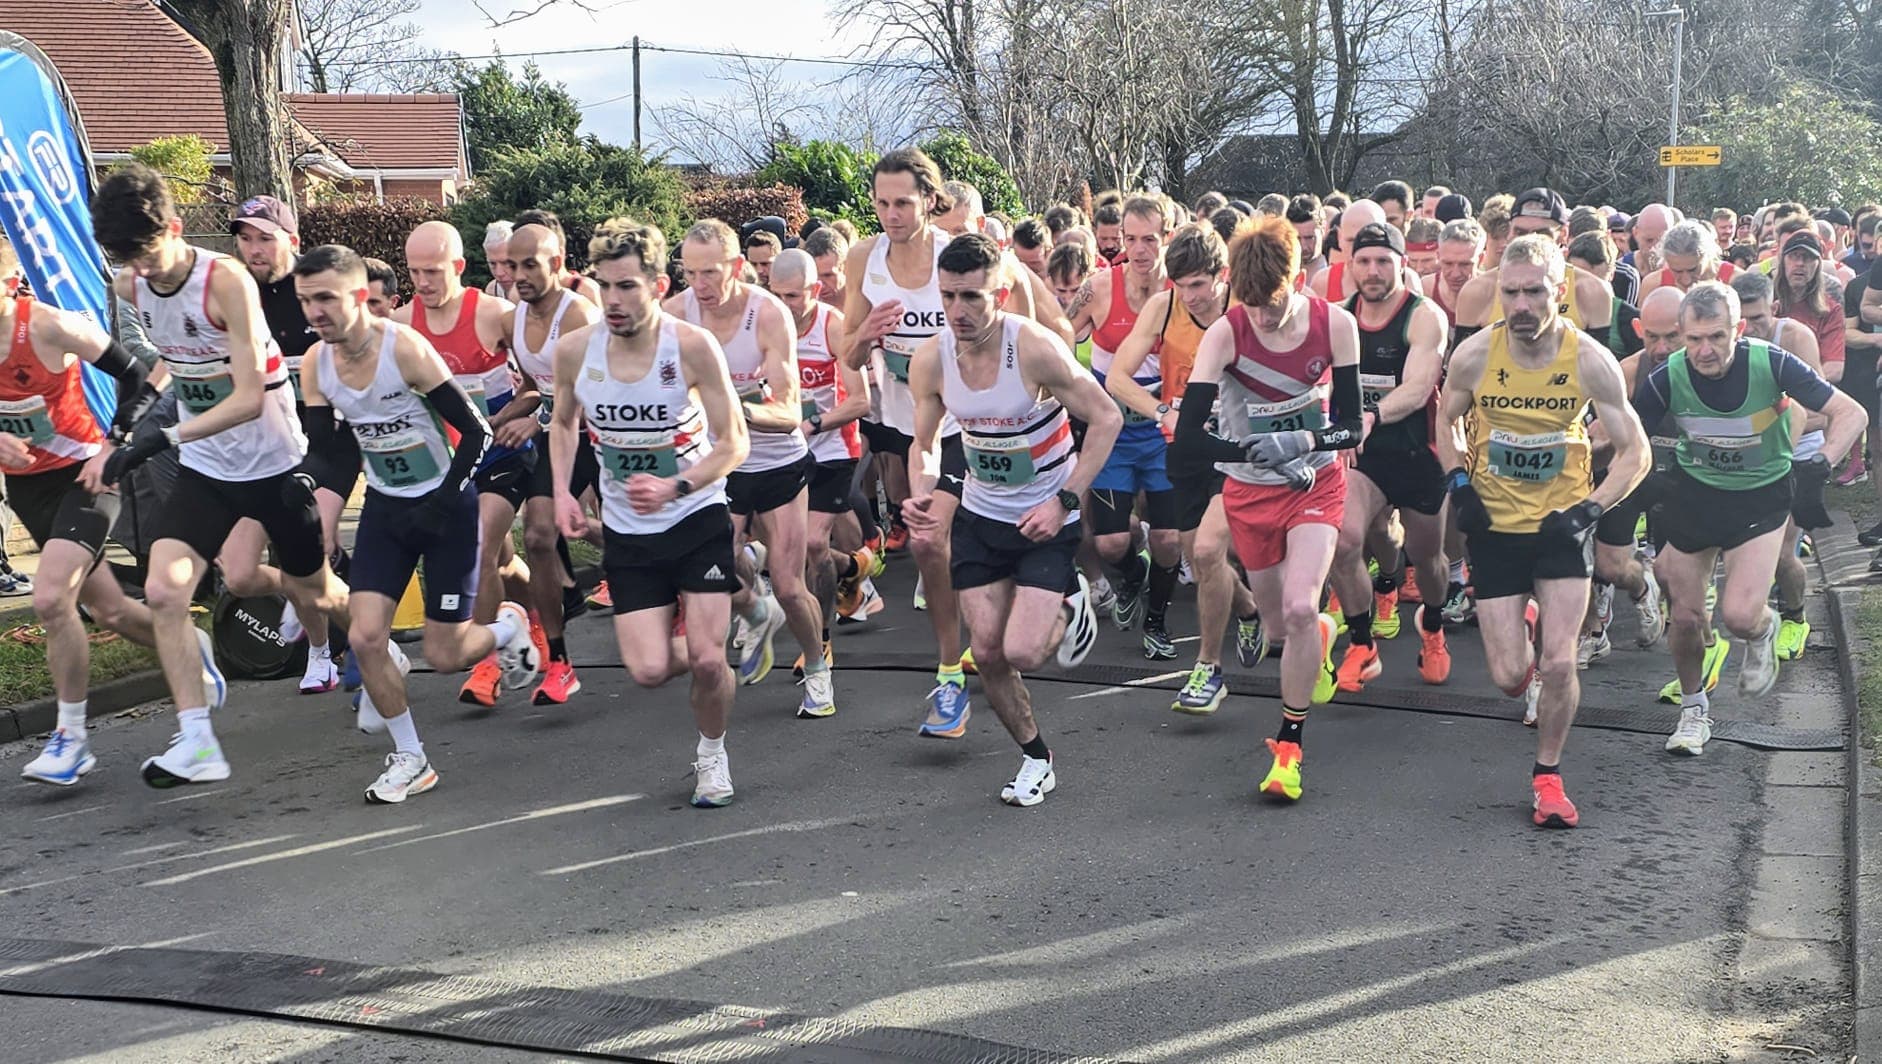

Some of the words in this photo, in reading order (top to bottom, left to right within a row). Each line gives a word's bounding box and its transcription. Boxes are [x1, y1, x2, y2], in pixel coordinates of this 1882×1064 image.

[0, 118, 80, 290] TART
[903, 311, 945, 327] OKE
[1006, 343, 1014, 370] soar
[181, 383, 217, 401] 846
[1480, 395, 1578, 410] STOCKPORT
[595, 404, 669, 422] STOKE
[0, 417, 35, 433] 211
[1270, 413, 1305, 432] 231
[617, 454, 659, 471] 222
[978, 455, 1012, 472] 569
[1504, 450, 1554, 470] 1042
[1708, 449, 1743, 463] 666
[385, 457, 410, 474] 93
[234, 608, 288, 648] MYLAPS
